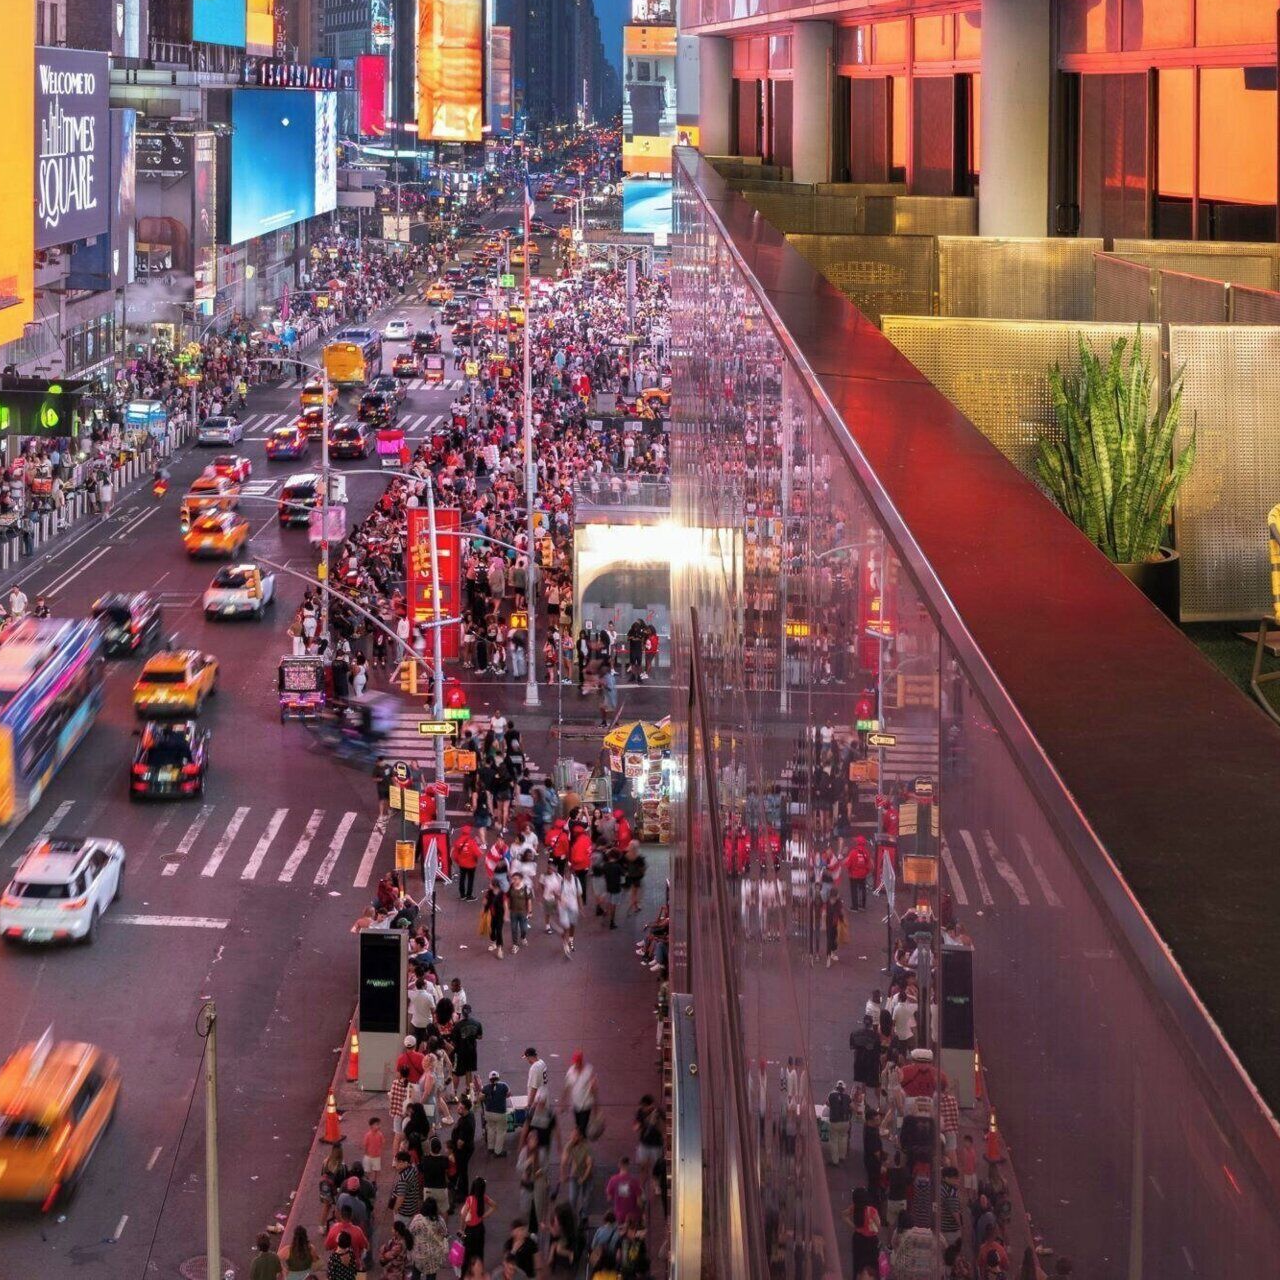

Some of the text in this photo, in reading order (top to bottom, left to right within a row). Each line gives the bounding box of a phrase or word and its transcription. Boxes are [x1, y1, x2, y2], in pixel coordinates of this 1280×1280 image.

[39, 64, 95, 95] WELCOME TO
[62, 115, 95, 154] TIMES
[39, 154, 97, 229] SQUARE
